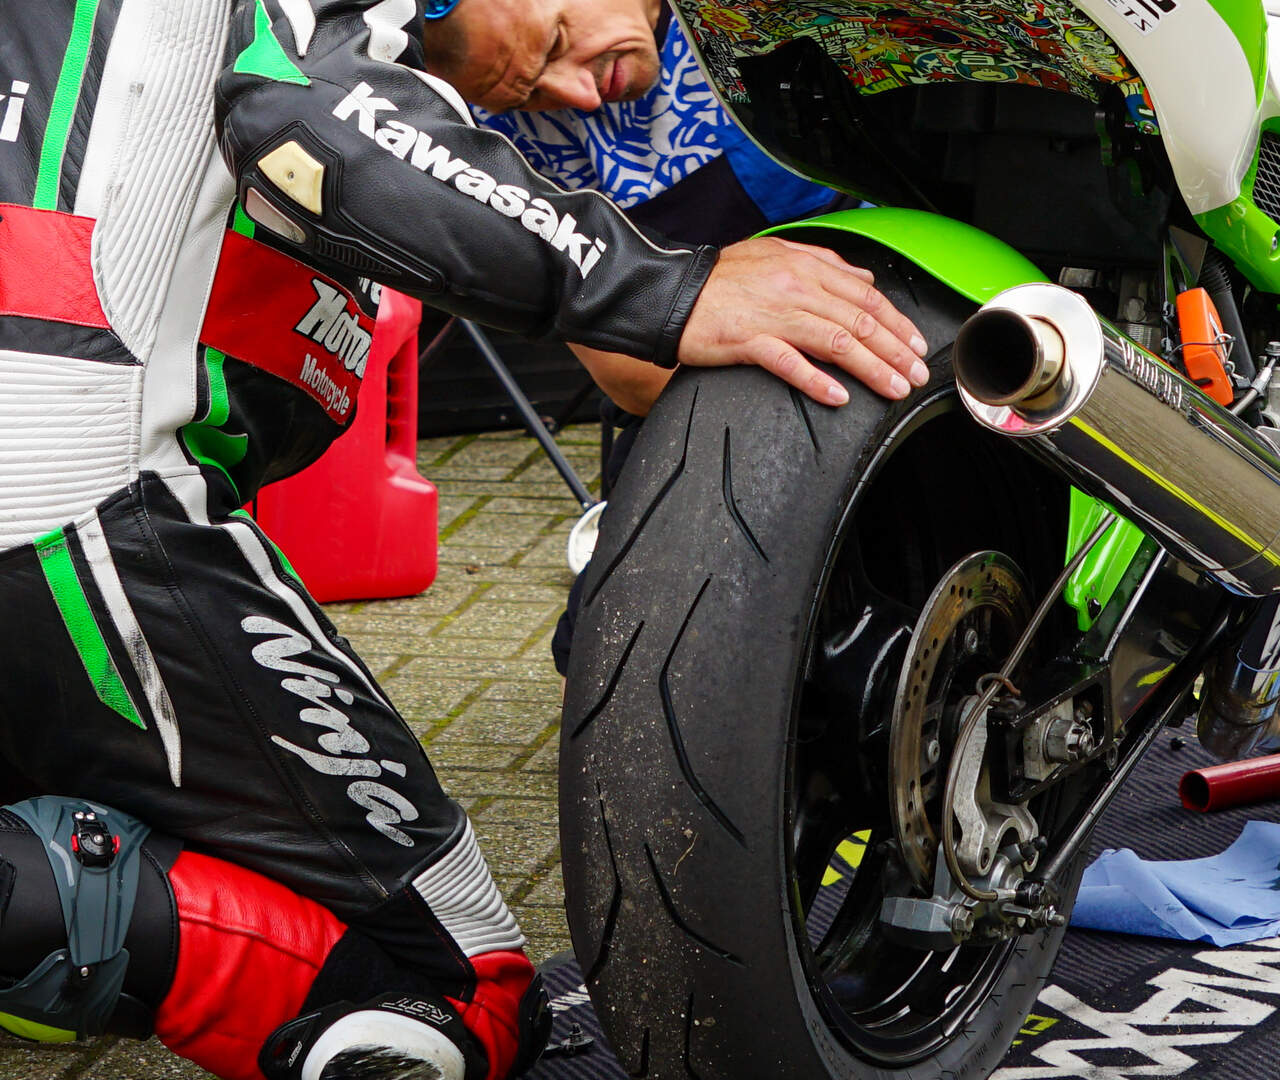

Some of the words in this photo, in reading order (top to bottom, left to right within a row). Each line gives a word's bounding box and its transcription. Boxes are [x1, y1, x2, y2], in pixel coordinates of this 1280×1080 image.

[331, 80, 608, 280] Kawasaki
[299, 352, 351, 416] Motorcycle
[240, 615, 420, 848] Ninja
